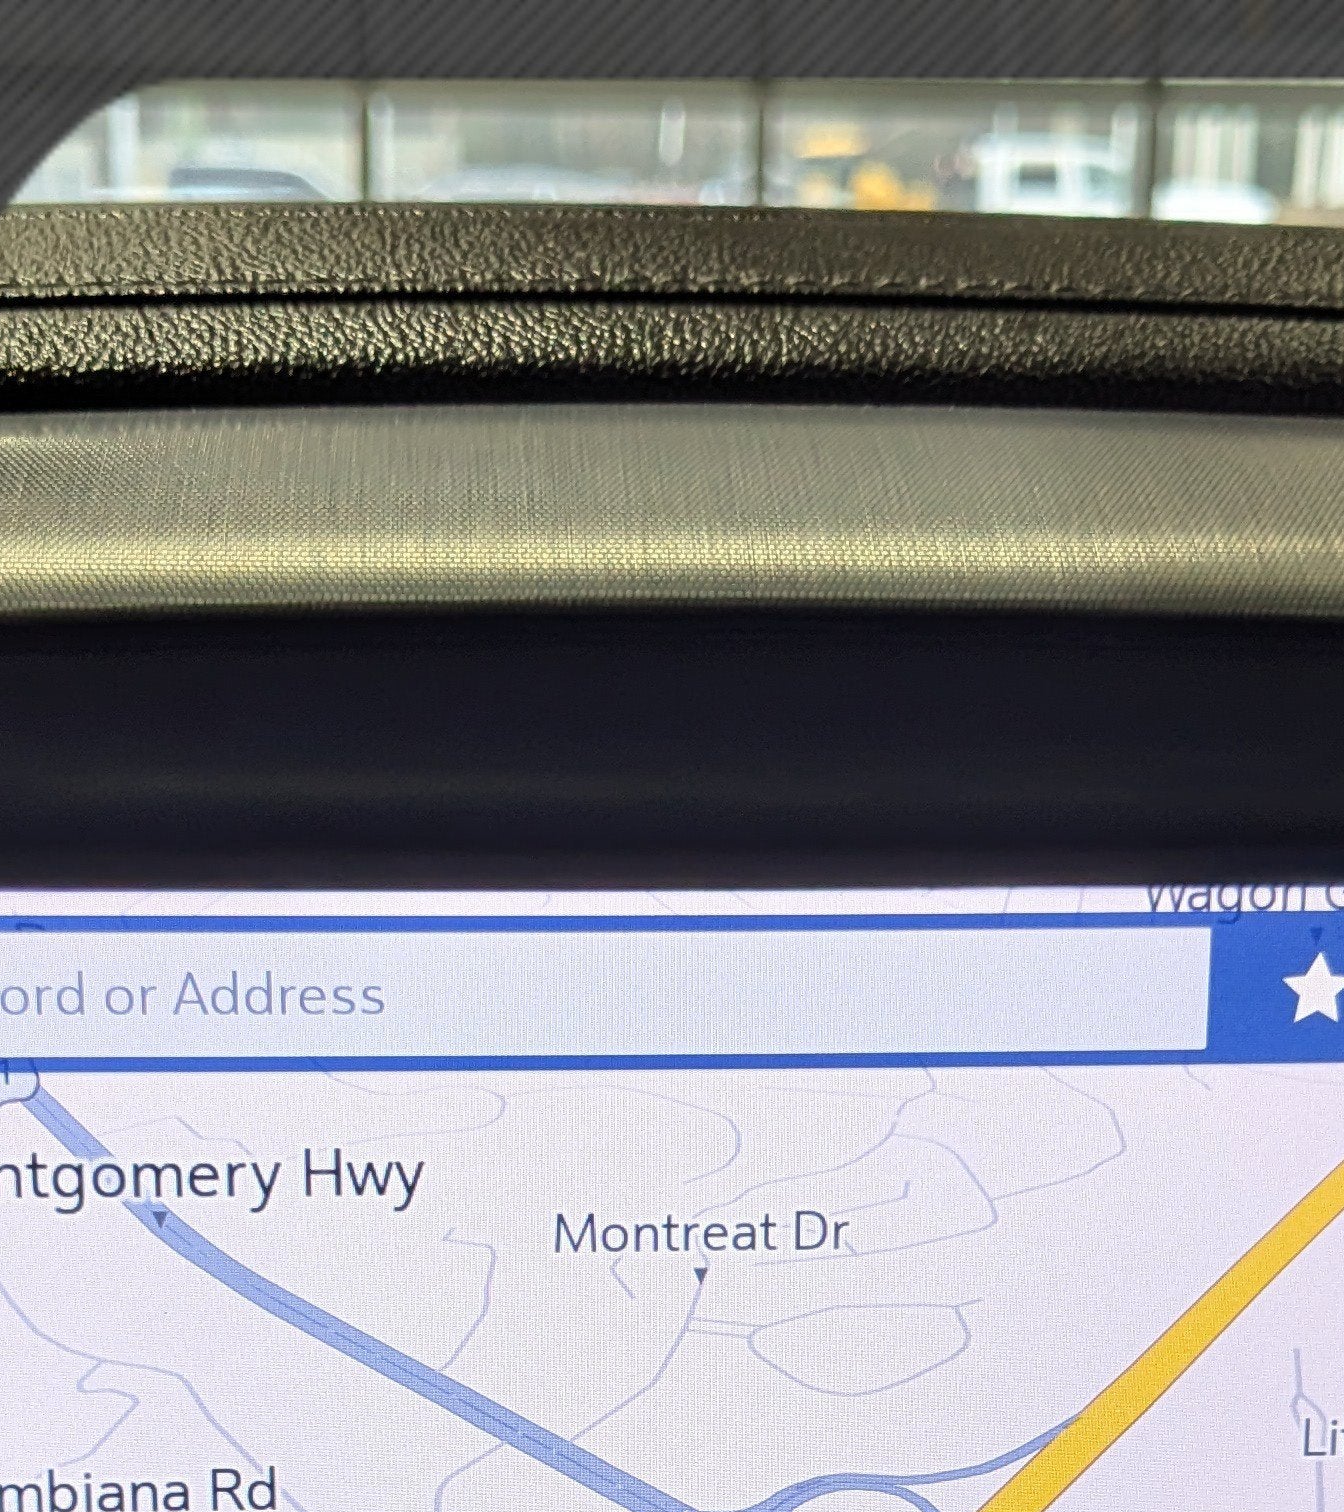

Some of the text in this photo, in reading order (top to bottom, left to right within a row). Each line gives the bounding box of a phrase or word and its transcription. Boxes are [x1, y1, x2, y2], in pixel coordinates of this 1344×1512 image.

[105, 985, 156, 1016] or
[172, 970, 386, 1016] Address
[304, 1148, 425, 1210] Hwy
[554, 1210, 850, 1254] Montreat Dr
[210, 1466, 278, 1512] Rd
